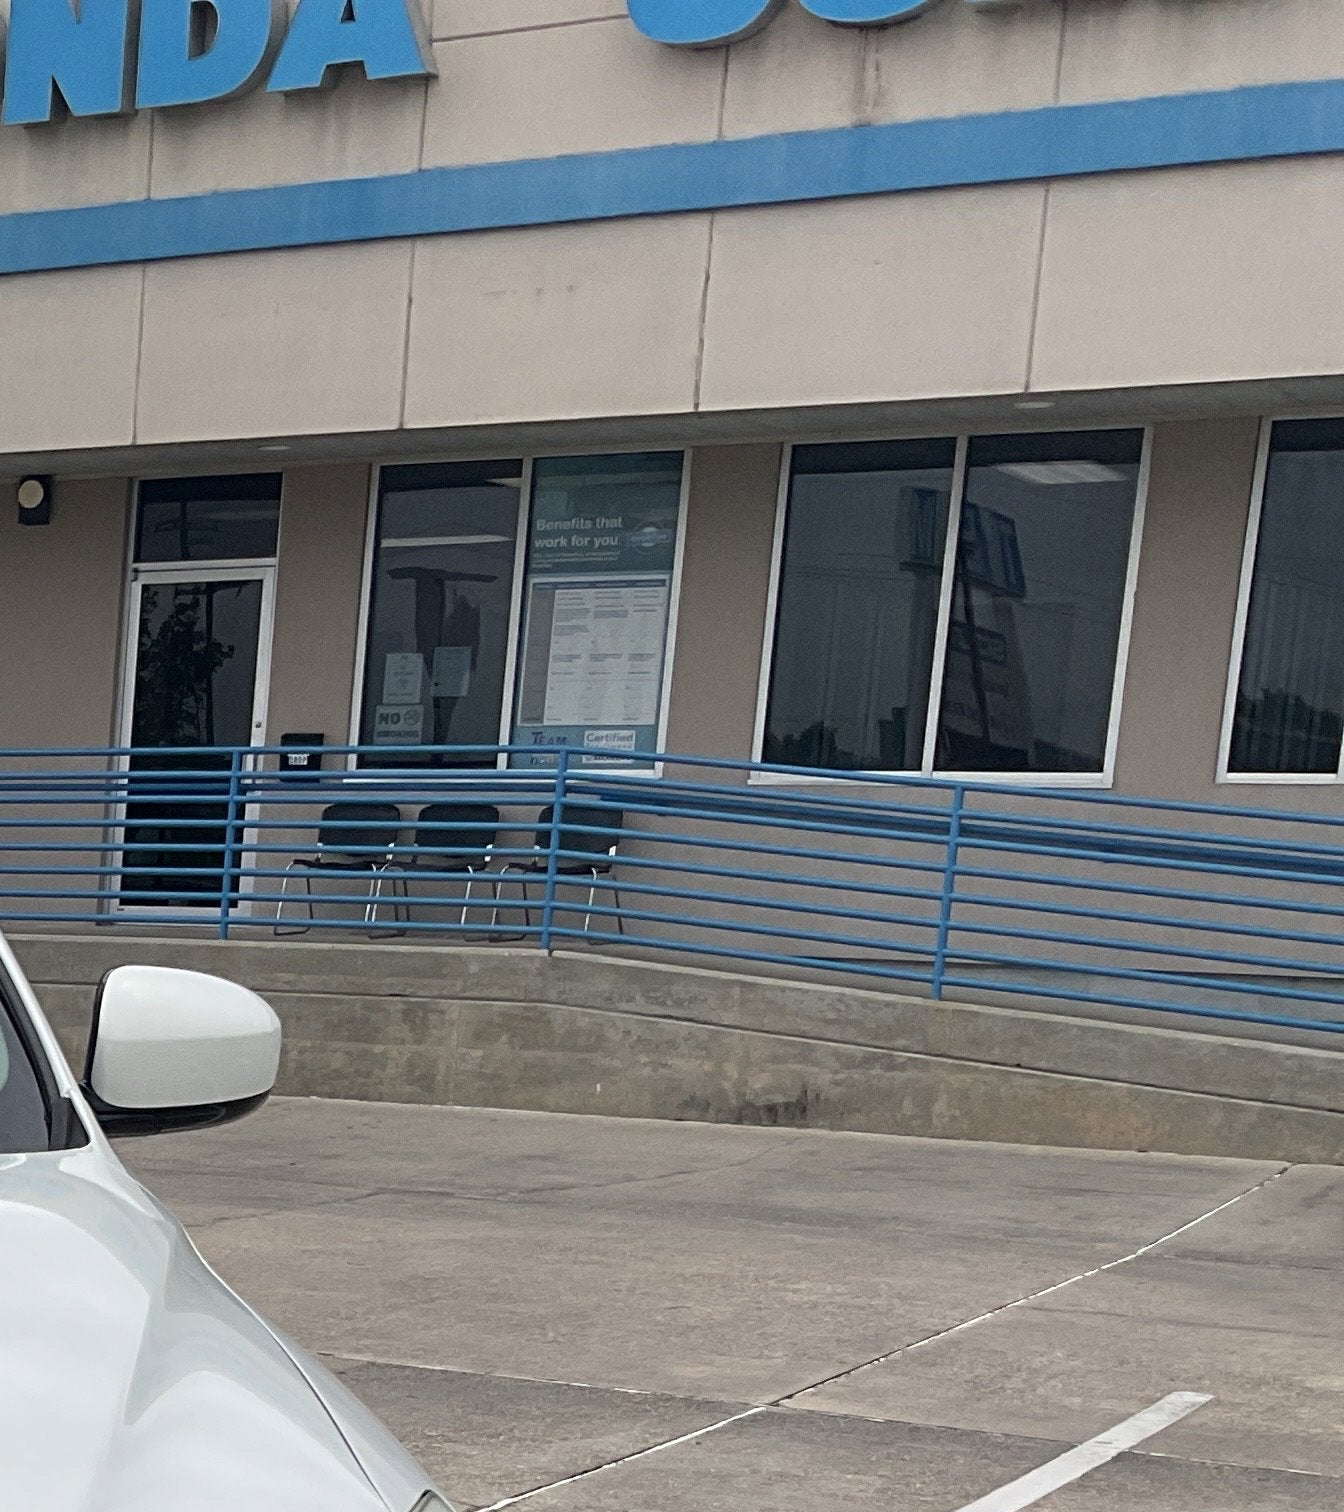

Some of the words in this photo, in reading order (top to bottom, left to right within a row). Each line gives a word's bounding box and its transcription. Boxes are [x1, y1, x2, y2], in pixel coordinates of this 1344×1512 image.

[536, 517, 593, 531] Benefits
[595, 515, 623, 529] that
[534, 535, 568, 548] work
[571, 534, 590, 547] for
[378, 712, 401, 725] NO
[586, 732, 633, 742] Certified
